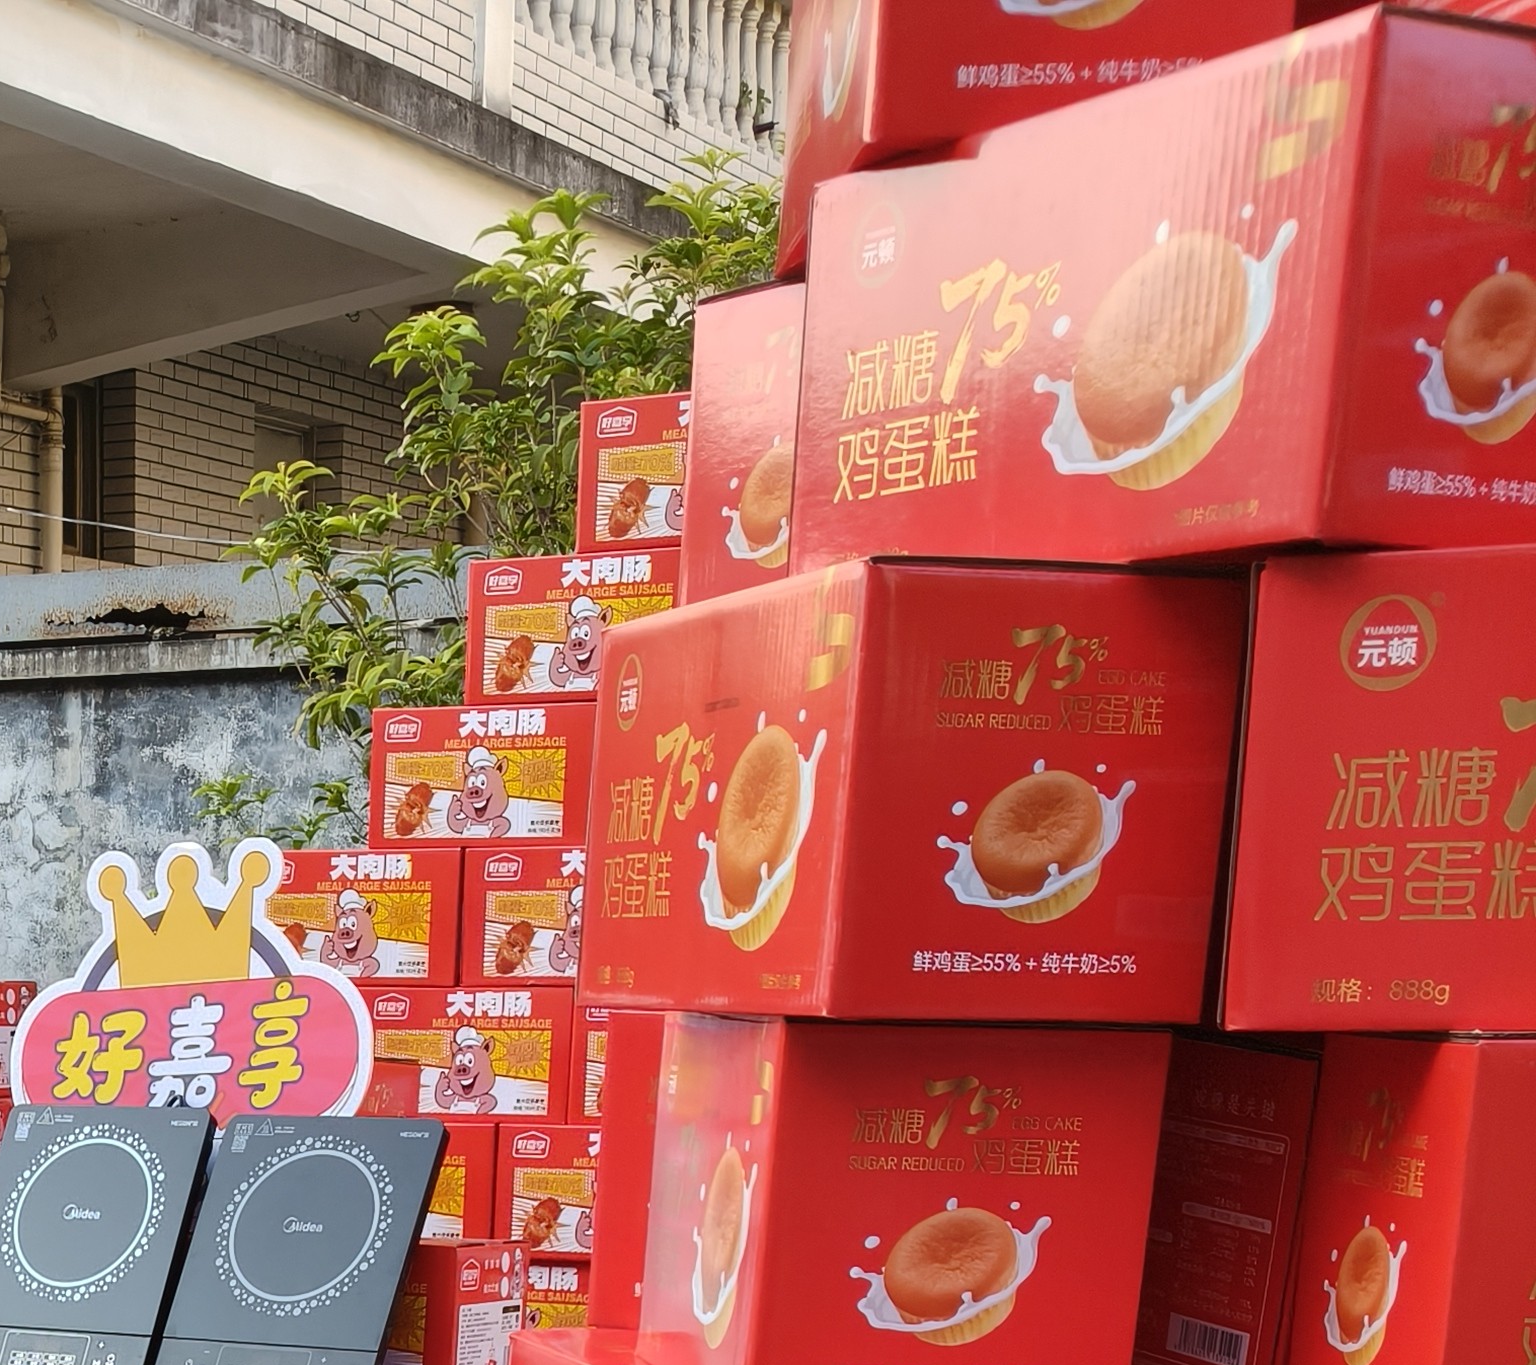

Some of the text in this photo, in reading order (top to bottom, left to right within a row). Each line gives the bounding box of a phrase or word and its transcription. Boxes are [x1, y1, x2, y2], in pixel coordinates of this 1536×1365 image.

[956, 63, 1074, 89] 鲜鸡蛋≥55%
[861, 237, 896, 270] 元顿
[841, 259, 1061, 421] 减糖 75%
[662, 428, 688, 440] MEA
[834, 405, 980, 503] 鸡蛋糕
[1388, 466, 1476, 498] 鲜鸡蛋≥55%
[560, 555, 652, 587] 大肉肠
[939, 659, 1013, 700] 减糖
[1012, 624, 1108, 705] 75%
[1358, 638, 1418, 668] 元顿
[458, 708, 546, 737] 大肉肠
[935, 695, 1166, 737] SUGAR REDUCED 鸡蛋糕
[607, 722, 716, 845] 减糖 75%
[1326, 747, 1498, 830] 减糖
[329, 854, 412, 880] 大肉肠
[601, 850, 673, 919] 鸡蛋糕
[913, 950, 1137, 975] 鲜鸡蛋≥55% 纯牛奶≥5%
[445, 991, 532, 1018] 大肉肠
[52, 981, 310, 1111] 好嘉享
[851, 1108, 925, 1145] 减糖
[924, 1075, 1023, 1150] 75%
[849, 1139, 1080, 1176] SUGAR REDUCED 鸡蛋糕
[63, 1203, 101, 1221] Midea
[282, 1216, 324, 1234] Midea
[527, 1264, 579, 1291] 肉肠
[547, 1291, 589, 1302] SAUSAG
